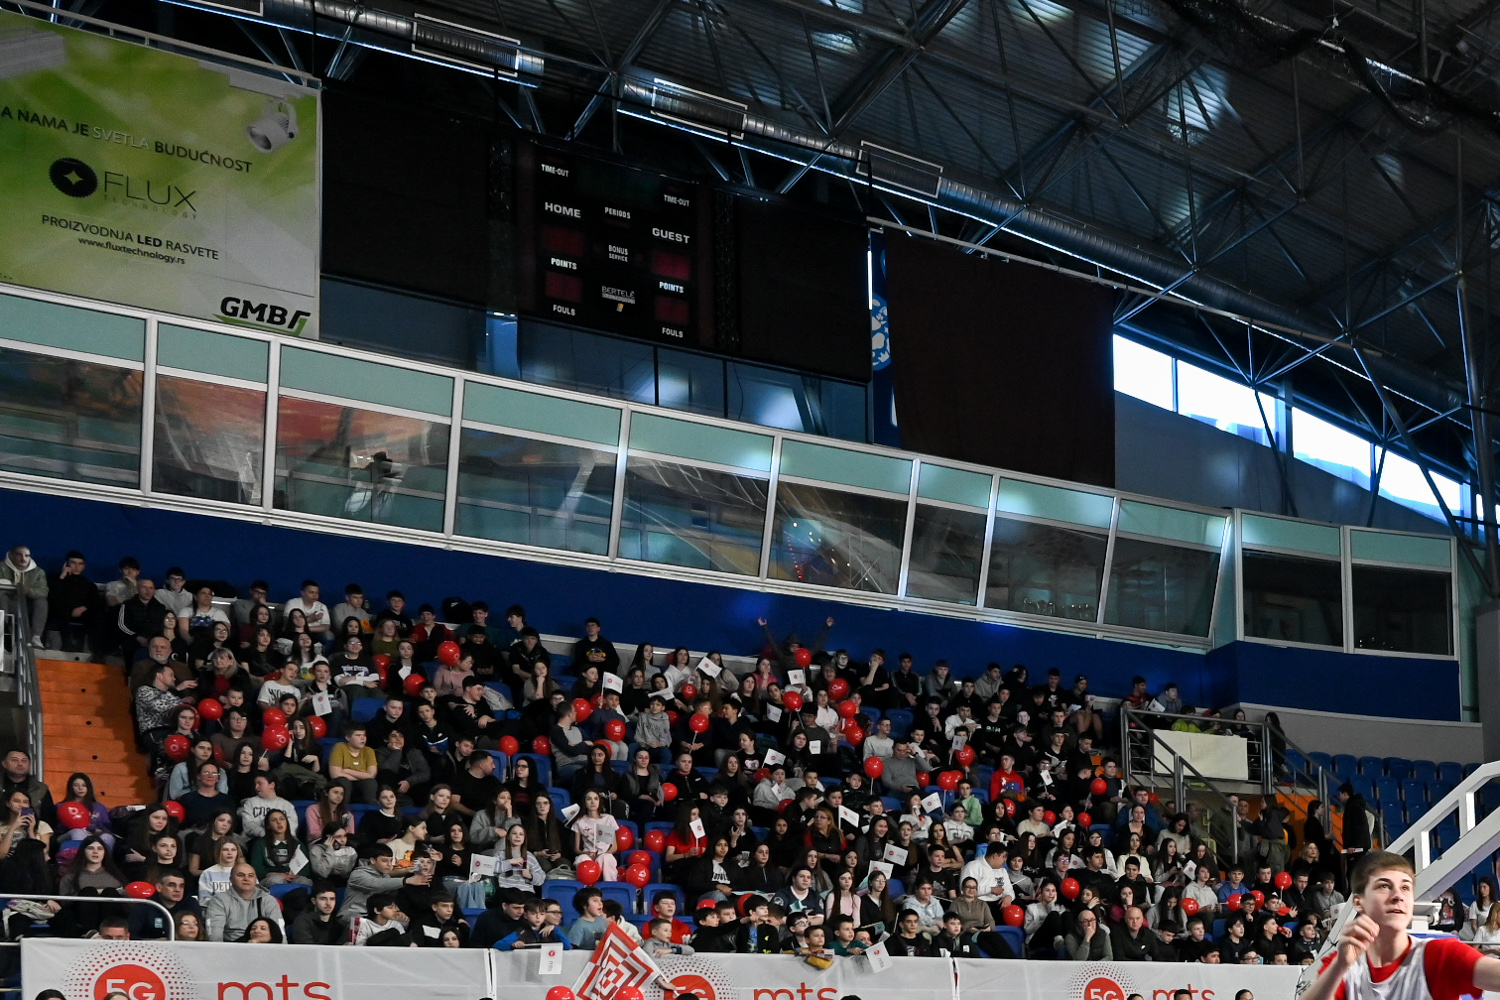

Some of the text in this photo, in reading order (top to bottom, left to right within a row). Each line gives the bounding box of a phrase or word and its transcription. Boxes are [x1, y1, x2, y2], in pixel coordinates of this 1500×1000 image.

[17, 109, 68, 132] NAMA
[72, 122, 89, 137] JE
[92, 127, 150, 149] SVETLA
[155, 141, 252, 173] BUDUĆNOST
[541, 163, 569, 178] TIME-OUT
[104, 171, 197, 212] FLUX
[104, 195, 197, 219] TECHNOLOGY
[664, 194, 690, 207] TIME-OUT
[544, 201, 581, 219] HOME
[604, 207, 631, 220] PERIODS
[42, 214, 219, 261] PROIZVODNJA LED RASVETE
[652, 227, 690, 244] GUEST
[78, 237, 186, 265] www.fluxtechnology.rs
[608, 244, 629, 256] BONUS
[550, 257, 578, 270] POINTS
[659, 281, 684, 294] POINTS
[553, 304, 576, 316] FOULS
[662, 327, 684, 338] FOULS
